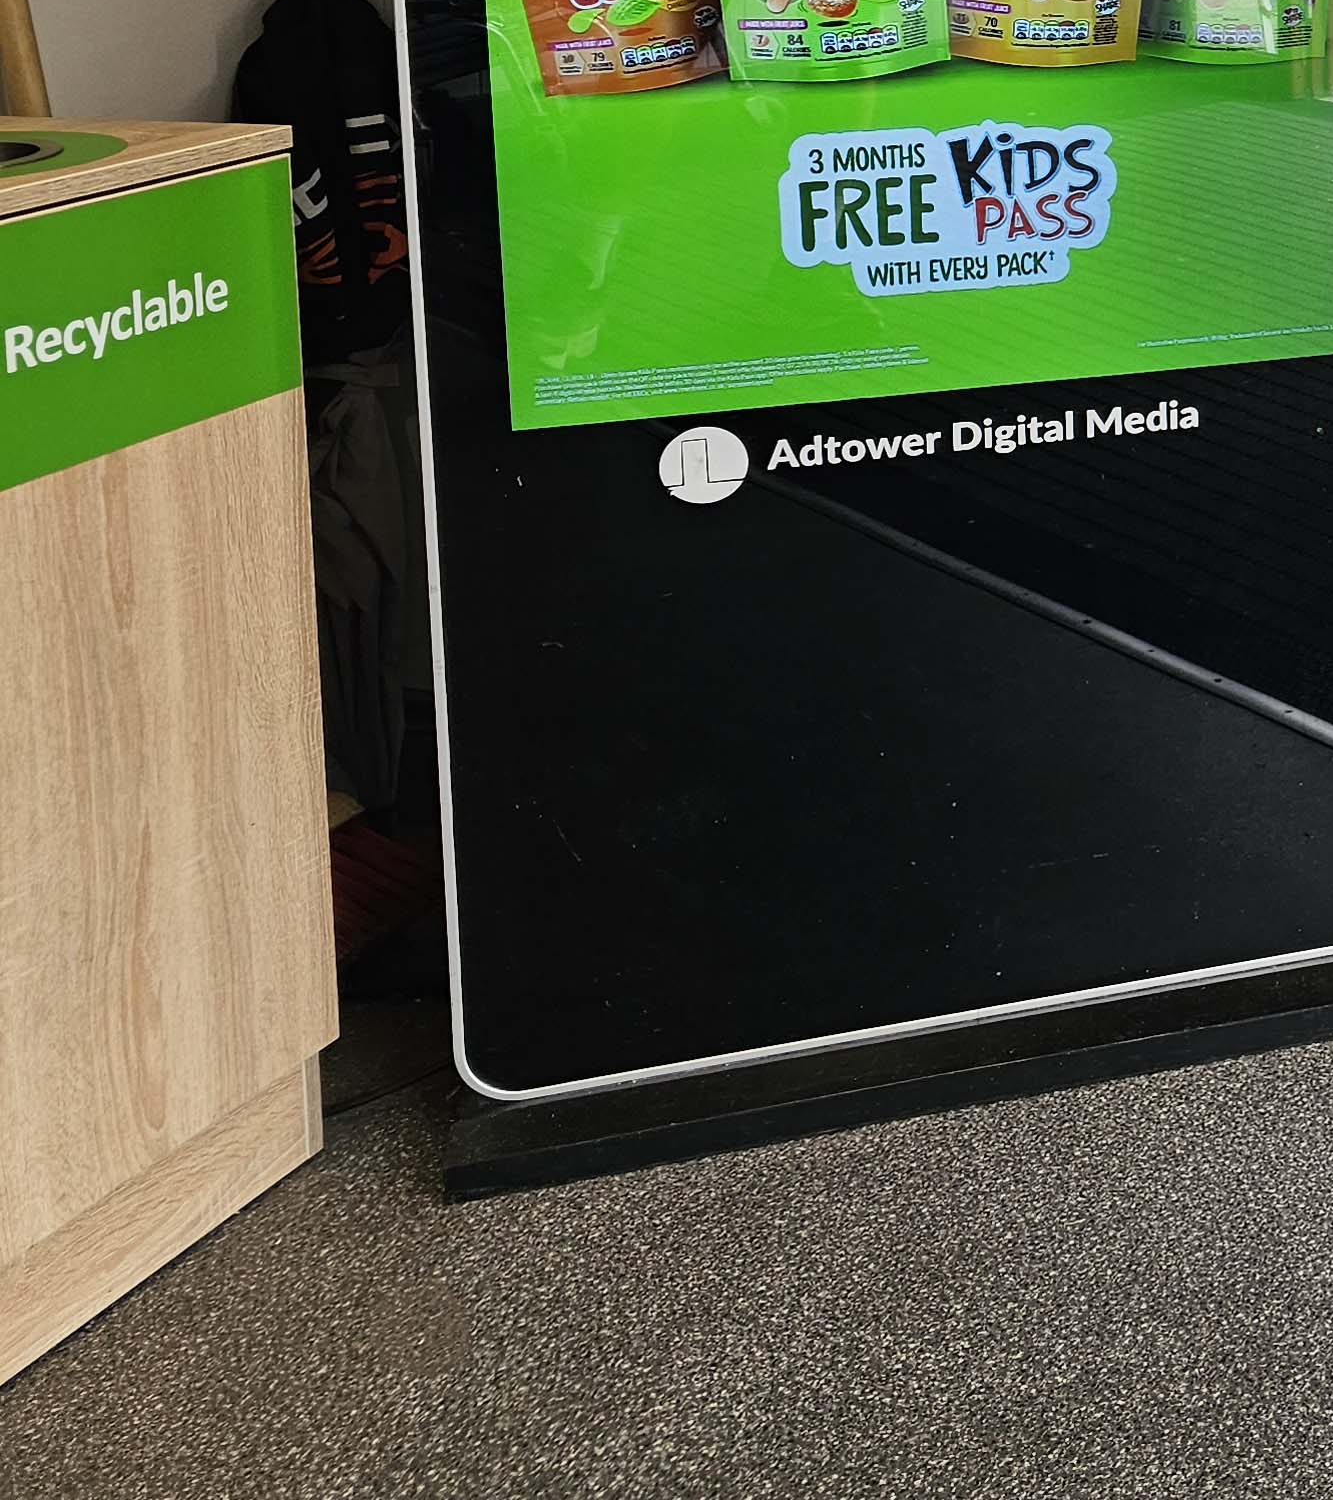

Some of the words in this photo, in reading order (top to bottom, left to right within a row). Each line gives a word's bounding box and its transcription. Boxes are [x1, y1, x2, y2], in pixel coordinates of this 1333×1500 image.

[809, 150, 824, 174] 3
[833, 143, 925, 173] MONTHS
[799, 174, 940, 251] FREE
[974, 192, 1095, 245] PASS
[929, 256, 989, 282] EVERY
[4, 271, 229, 373] Recyclable
[767, 427, 942, 471] Adtower
[952, 410, 1076, 454] Digital
[1086, 399, 1200, 438] Media
